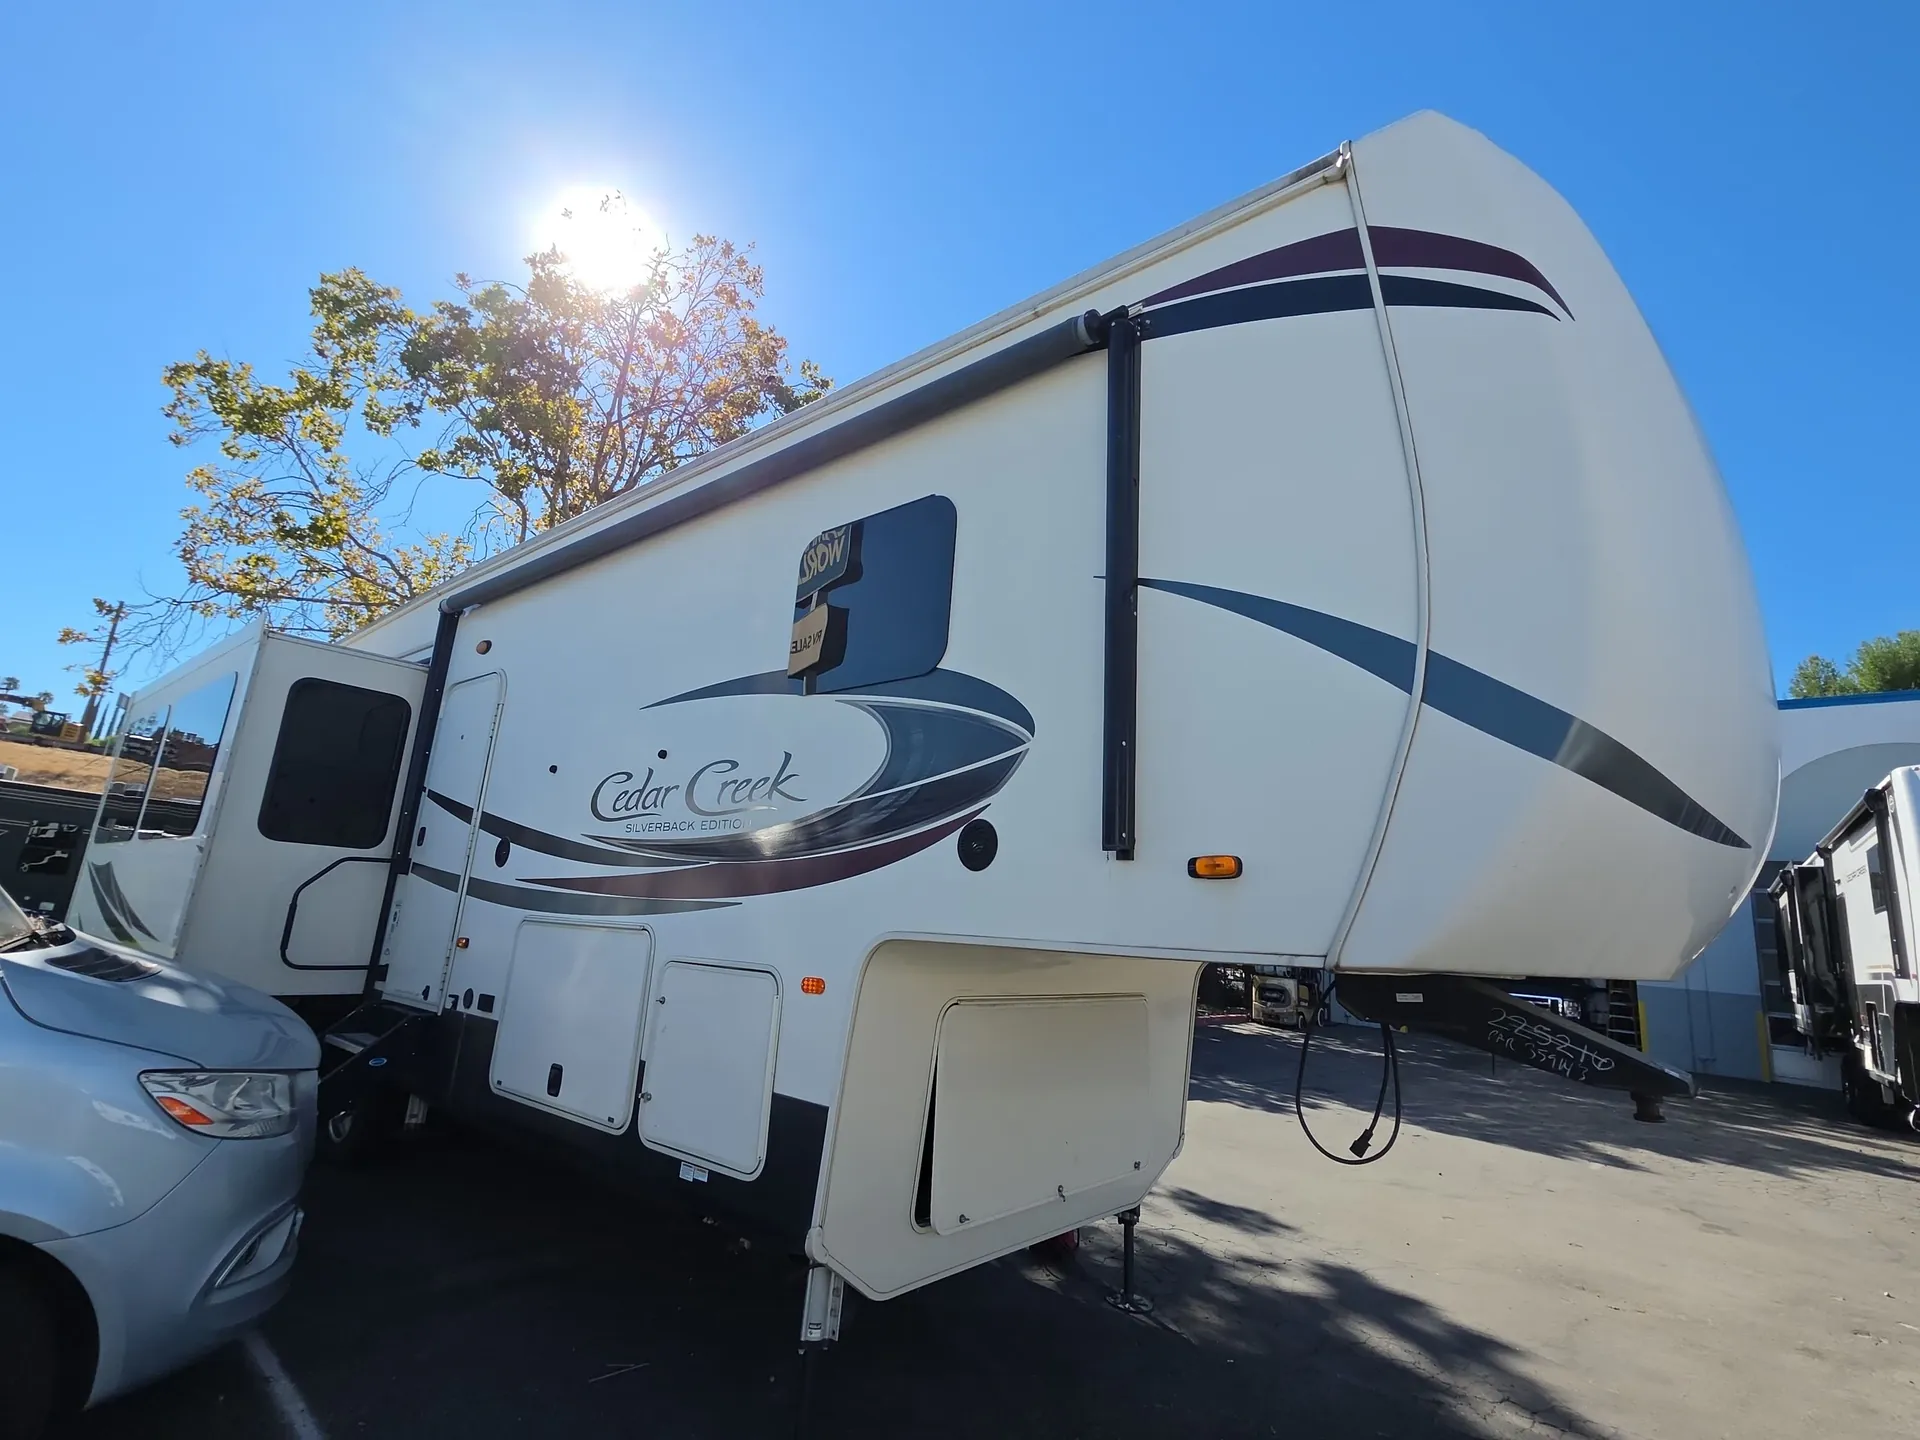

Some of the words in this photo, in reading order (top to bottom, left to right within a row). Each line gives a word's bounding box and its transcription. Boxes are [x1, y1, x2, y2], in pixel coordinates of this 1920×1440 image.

[590, 766, 680, 822] Cedar
[684, 750, 808, 817] Creek
[625, 821, 695, 833] SILVERBACK
